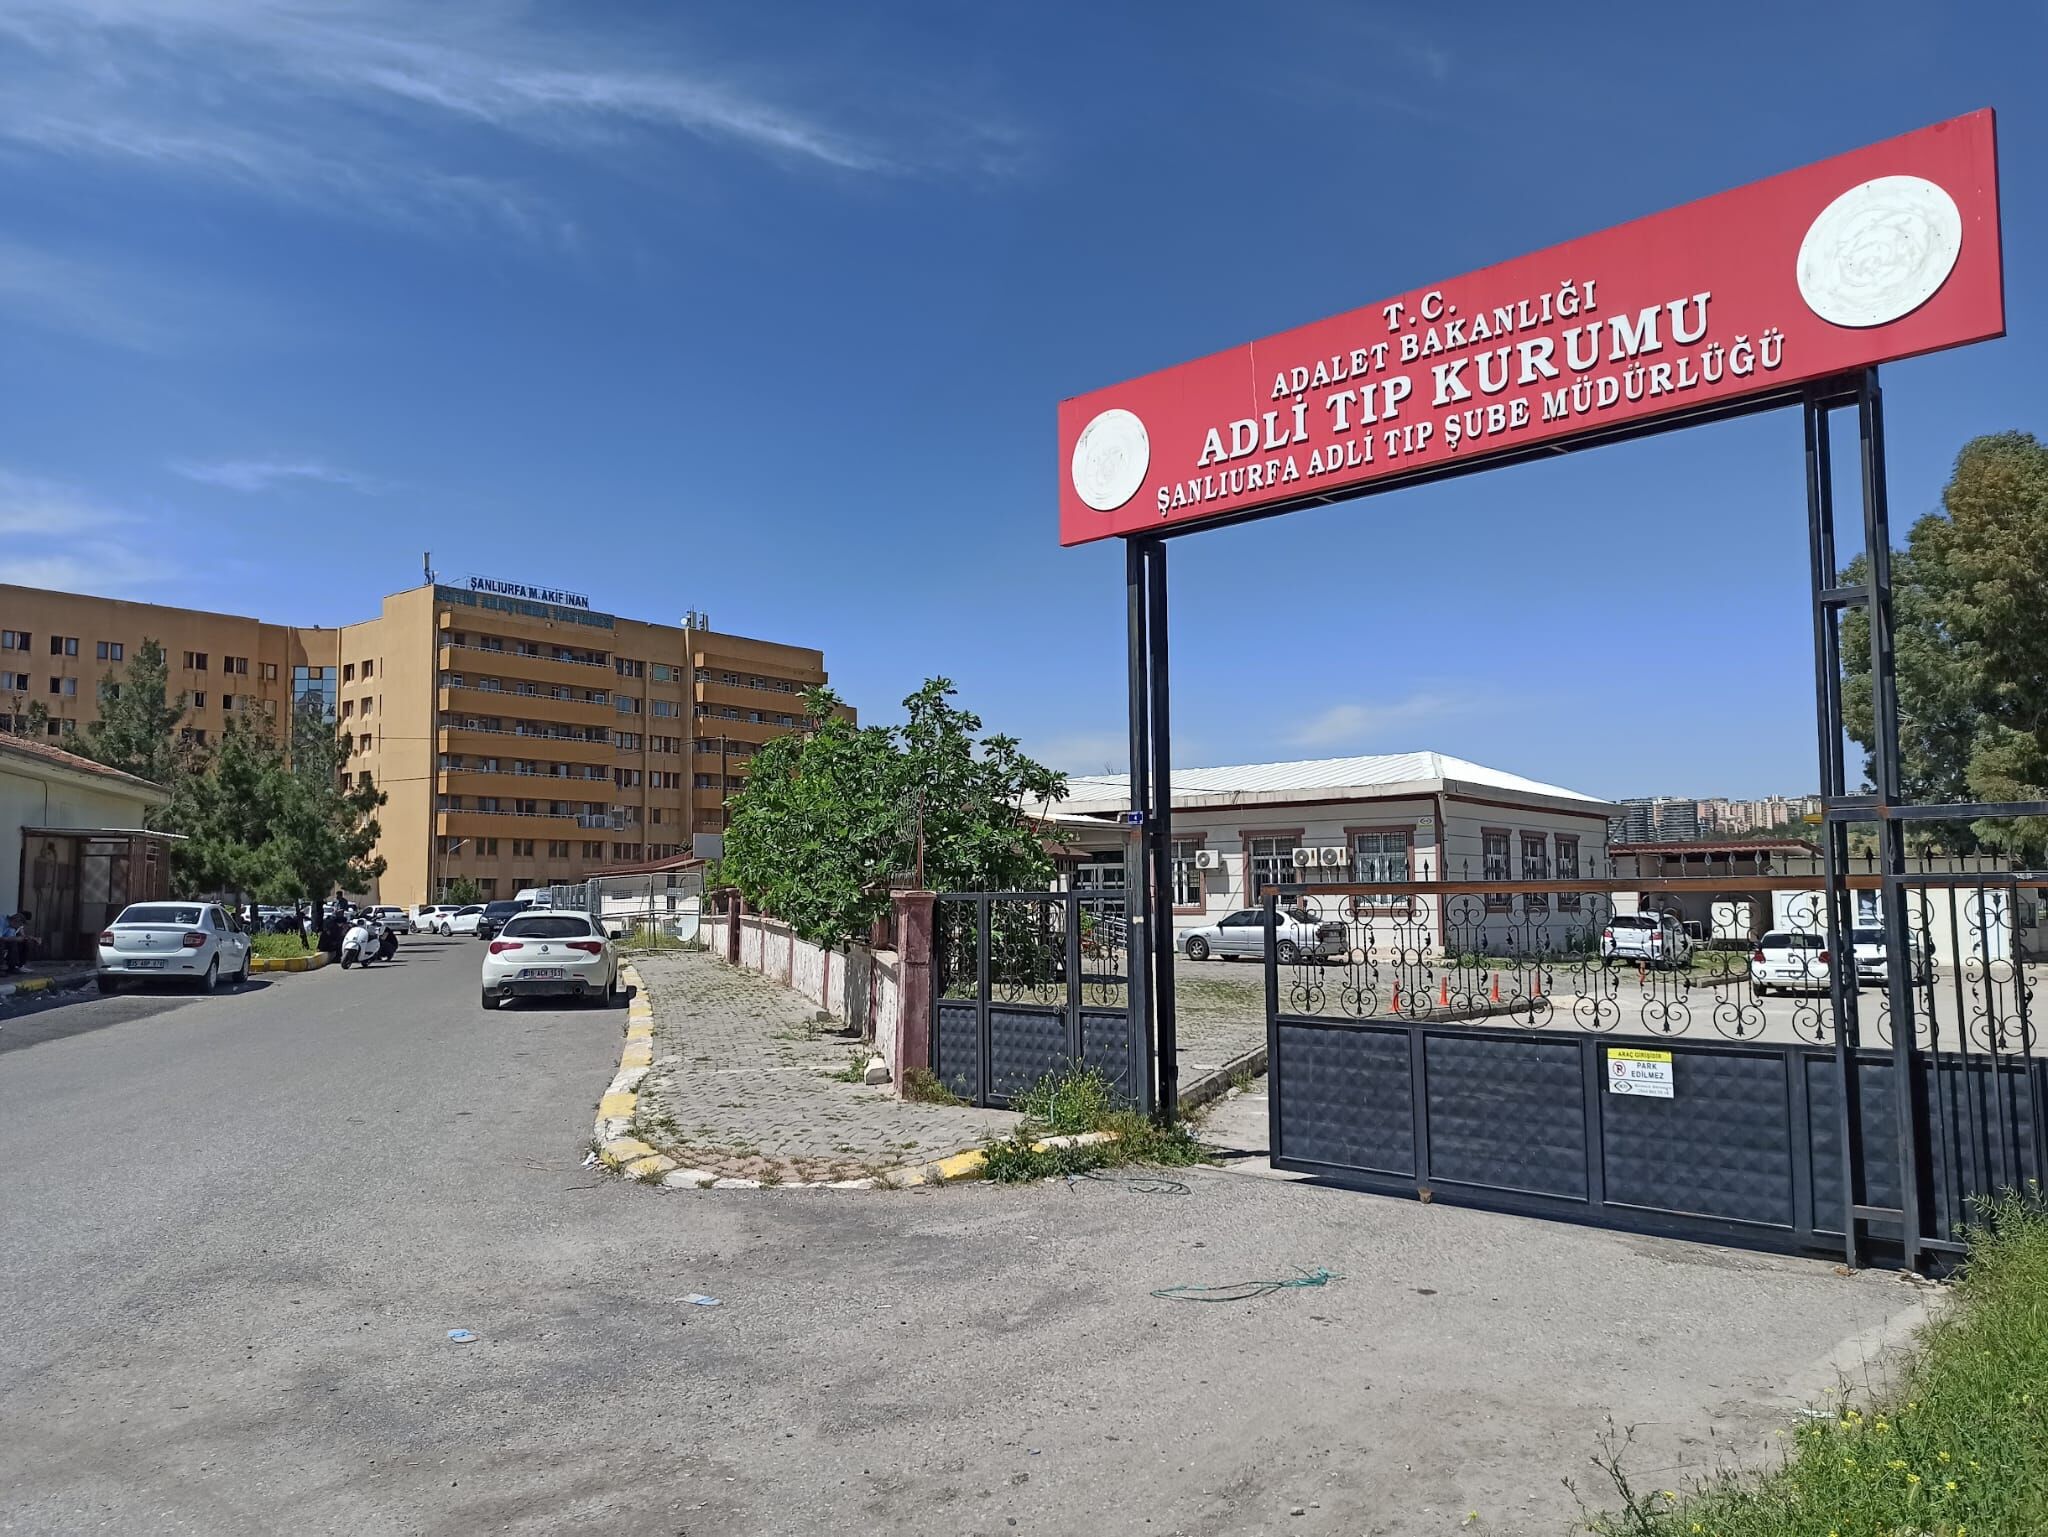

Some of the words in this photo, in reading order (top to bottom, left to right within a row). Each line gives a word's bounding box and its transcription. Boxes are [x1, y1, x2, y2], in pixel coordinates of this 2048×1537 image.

[1382, 290, 1457, 331] T.C.
[1270, 341, 1390, 400] ADALET
[1399, 278, 1597, 363] BAKANLIĞI
[1197, 393, 1309, 468] ADLİ
[1325, 375, 1413, 433] TIP
[1431, 291, 1713, 407] KURUMU
[1157, 455, 1300, 516] ŞANLIURFA
[1306, 432, 1374, 476] ADLİ
[1383, 421, 1434, 457] TIP
[1444, 397, 1531, 449] ŞUBE
[1541, 326, 1786, 421] MÜDÜRLÜĞÜ
[470, 576, 527, 598] ŞANLIURFA
[565, 589, 588, 608] İNAN
[1631, 1070, 1665, 1079] EDİLMEZ
[1636, 1062, 1657, 1070] PARK
